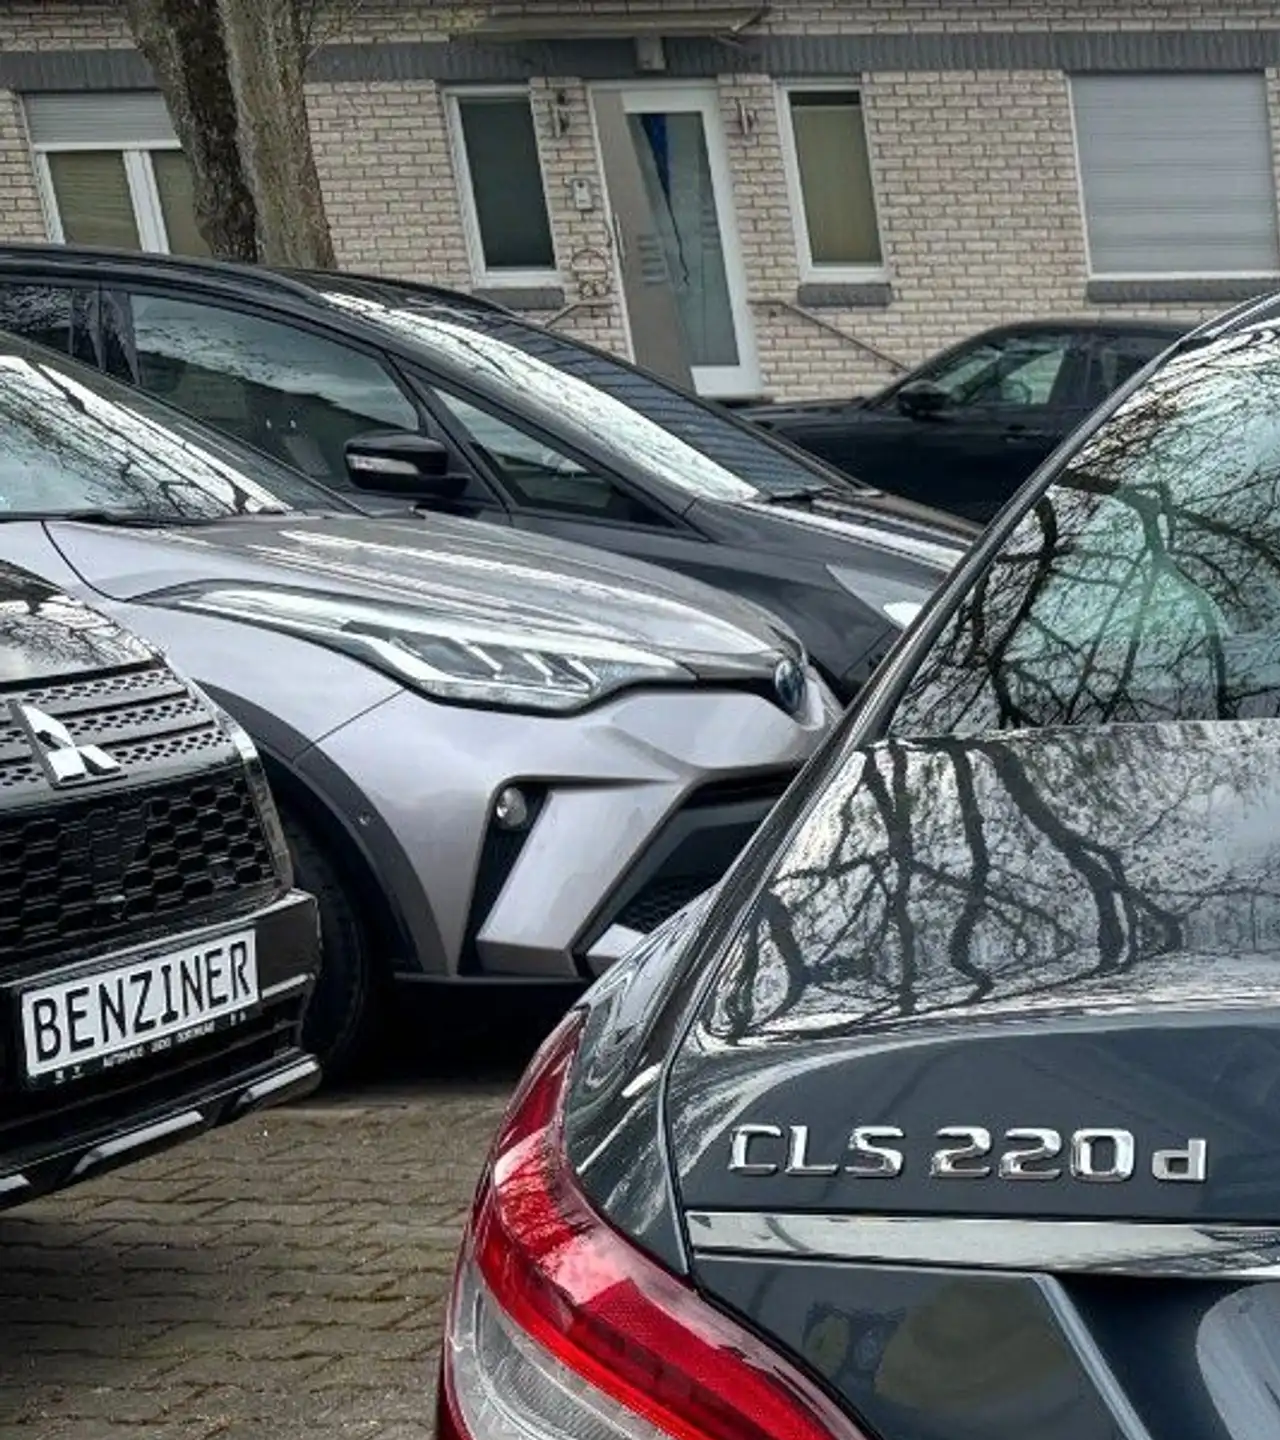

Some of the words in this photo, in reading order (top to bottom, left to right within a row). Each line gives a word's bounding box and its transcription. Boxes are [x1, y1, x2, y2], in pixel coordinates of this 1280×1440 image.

[33, 940, 252, 1062] BENZINER
[727, 1124, 905, 1180] CLS
[931, 1126, 1134, 1182] 220
[1151, 1138, 1207, 1182] d
